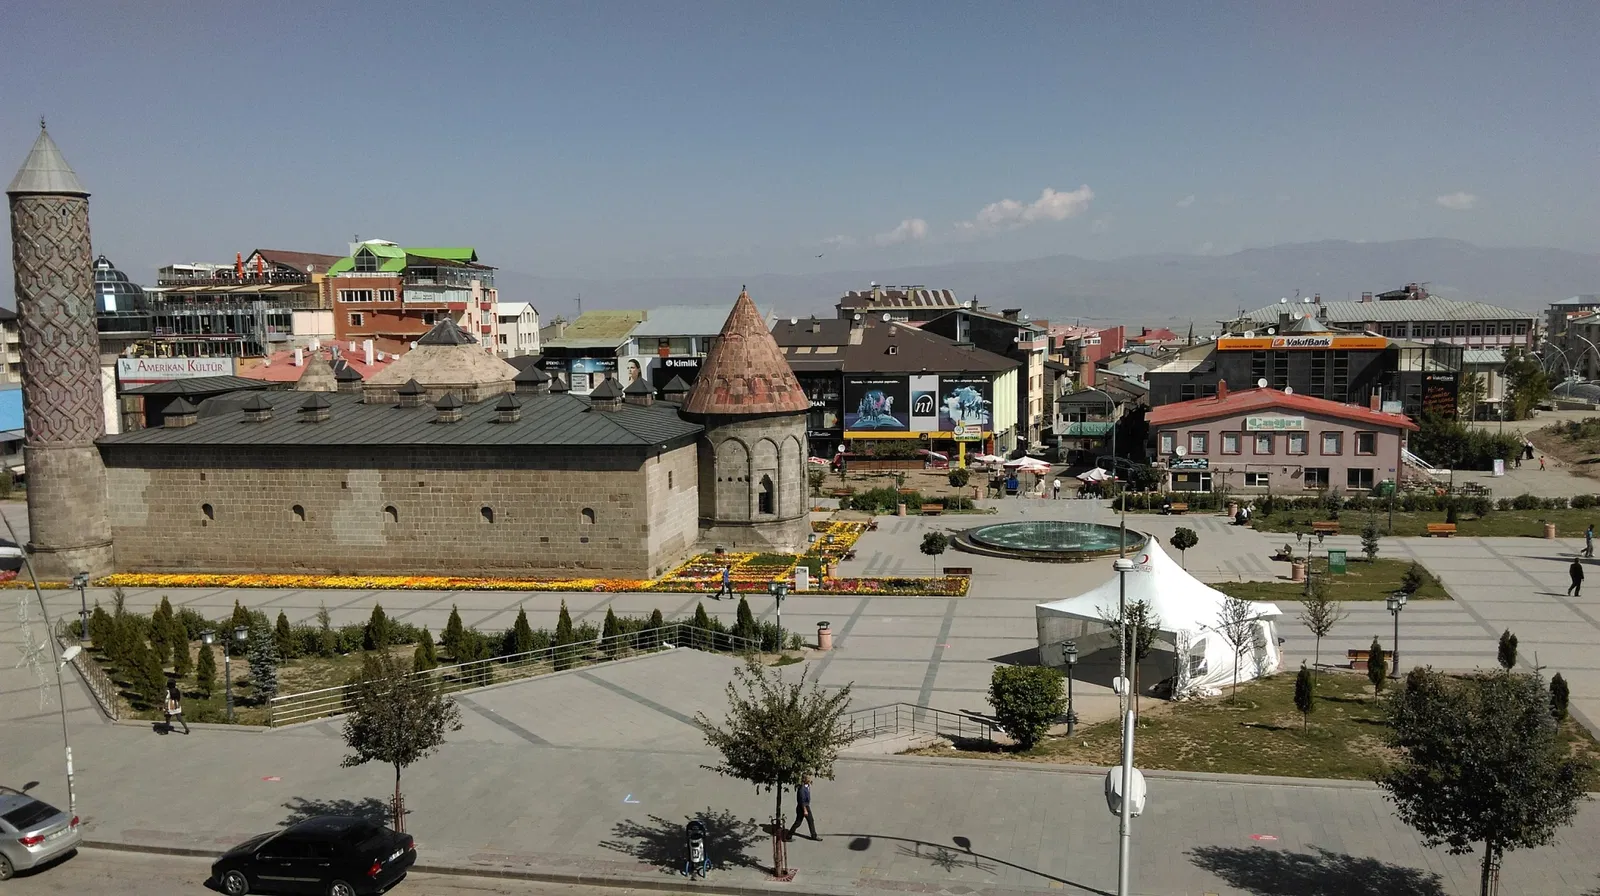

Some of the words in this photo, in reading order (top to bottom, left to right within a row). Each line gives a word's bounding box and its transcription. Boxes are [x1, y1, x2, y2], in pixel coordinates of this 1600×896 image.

[1286, 338, 1331, 347] VakıfBank
[187, 359, 224, 372] KÜLTÜR
[673, 359, 698, 367] kimlik
